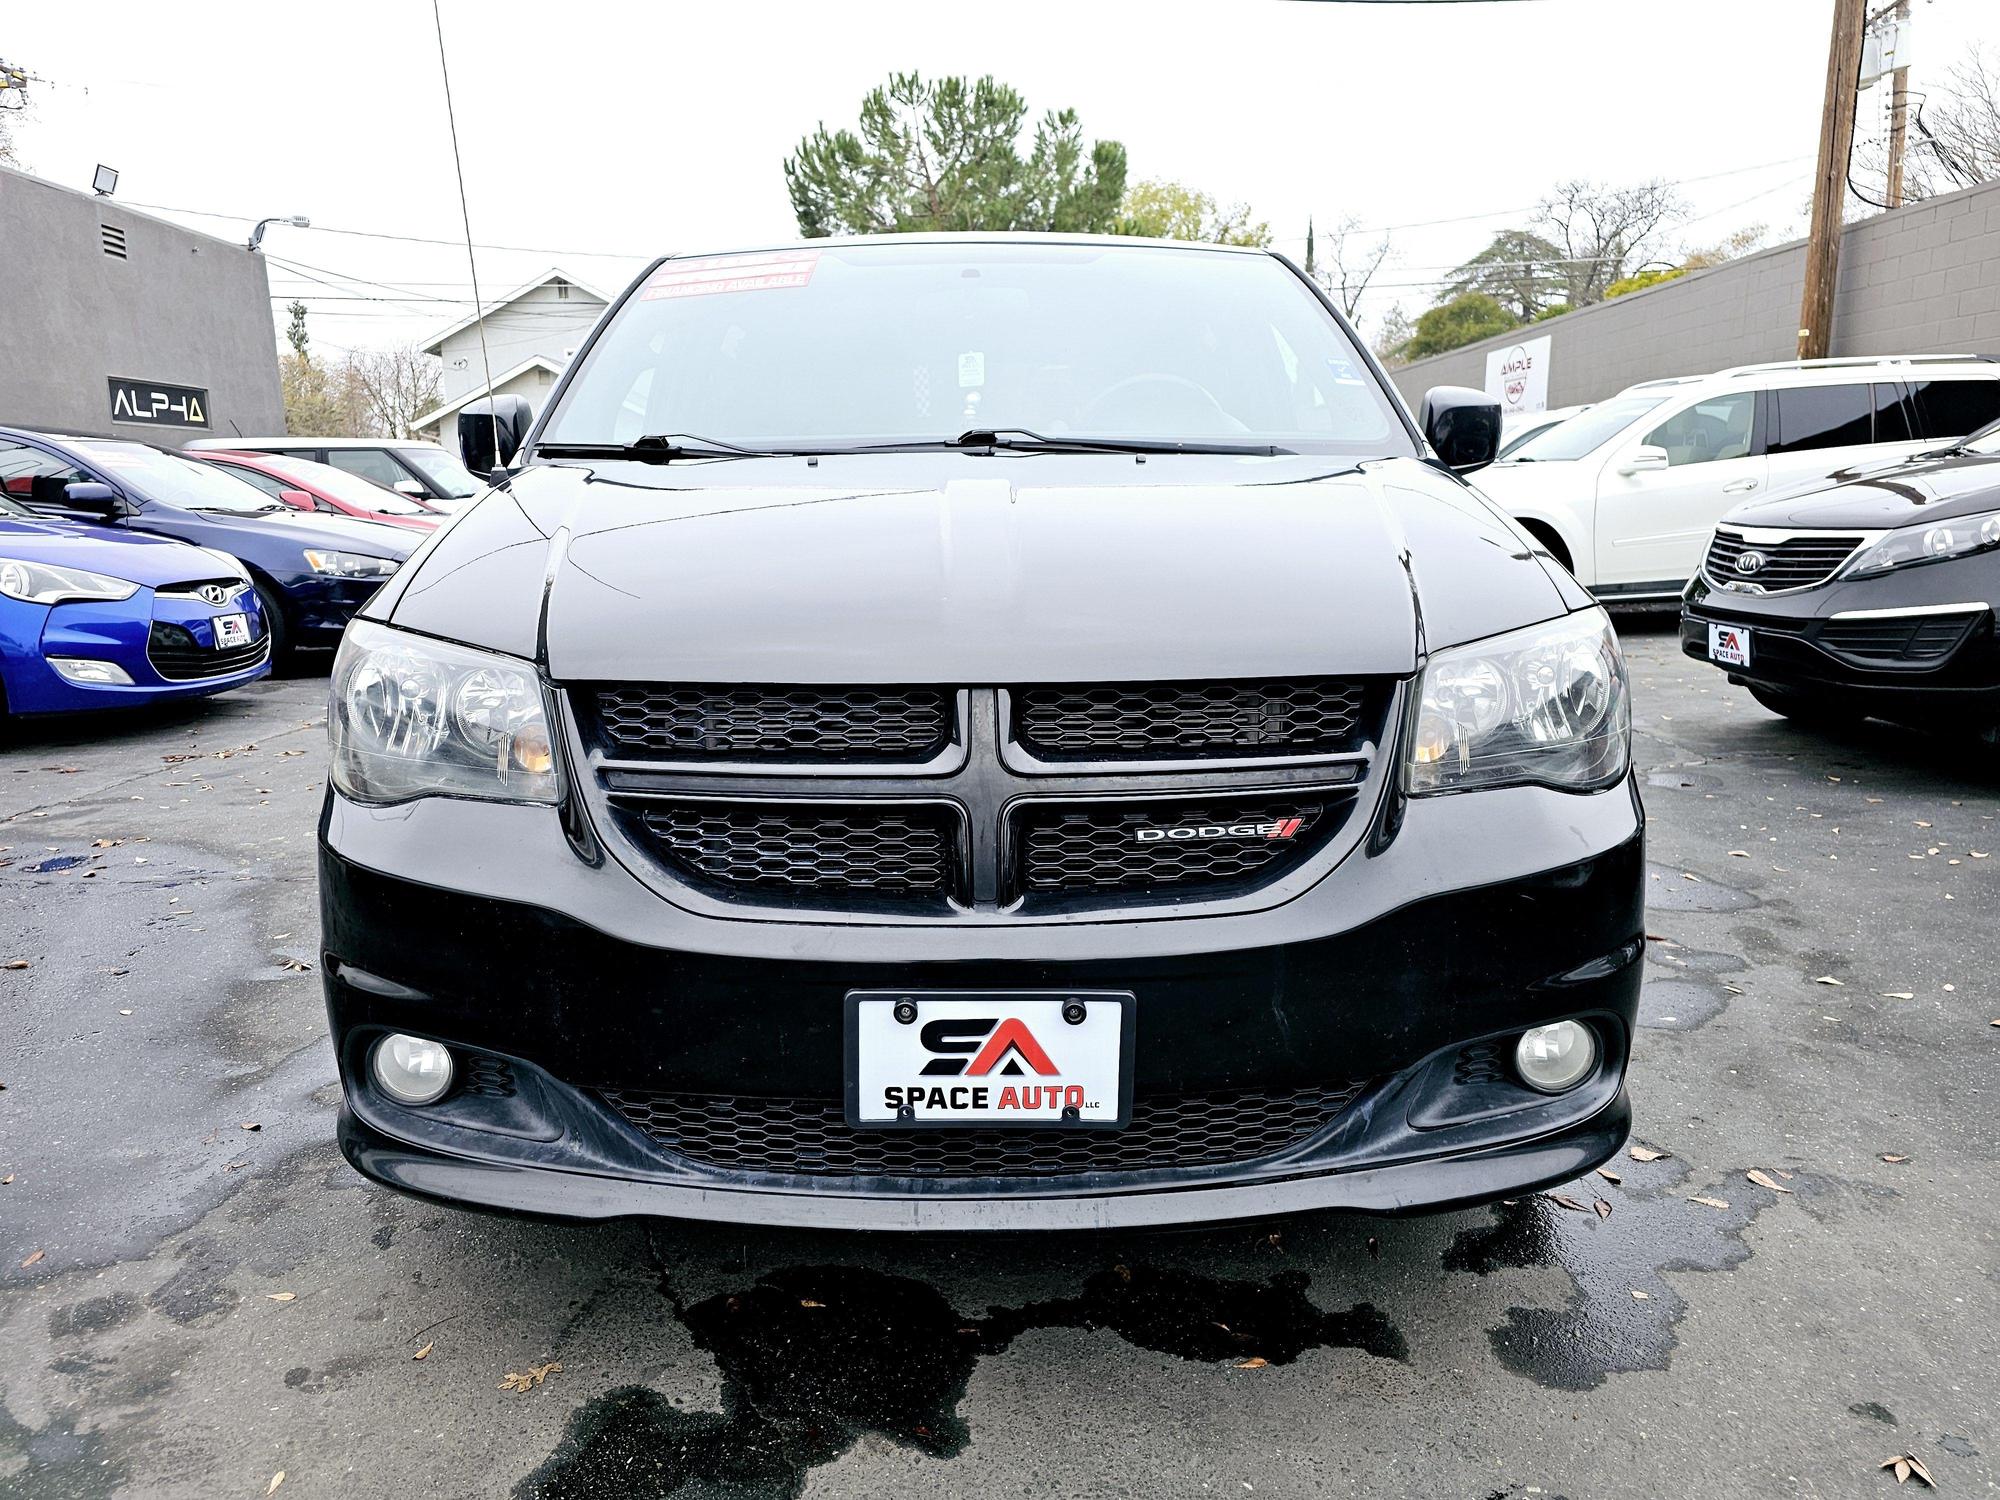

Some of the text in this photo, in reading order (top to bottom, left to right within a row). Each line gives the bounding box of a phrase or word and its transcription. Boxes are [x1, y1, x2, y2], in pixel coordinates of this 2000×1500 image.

[726, 274, 805, 290] AVAILABLE
[1501, 357, 1532, 375] AMPLE
[114, 389, 205, 422] ALPHA
[1739, 556, 1757, 570] KIA
[1712, 648, 1745, 662] SPACE AUTO
[1137, 823, 1282, 841] DODGE
[919, 1018, 1061, 1075] SA
[884, 1086, 988, 1110] SPACE
[997, 1085, 1085, 1110] AUTO
